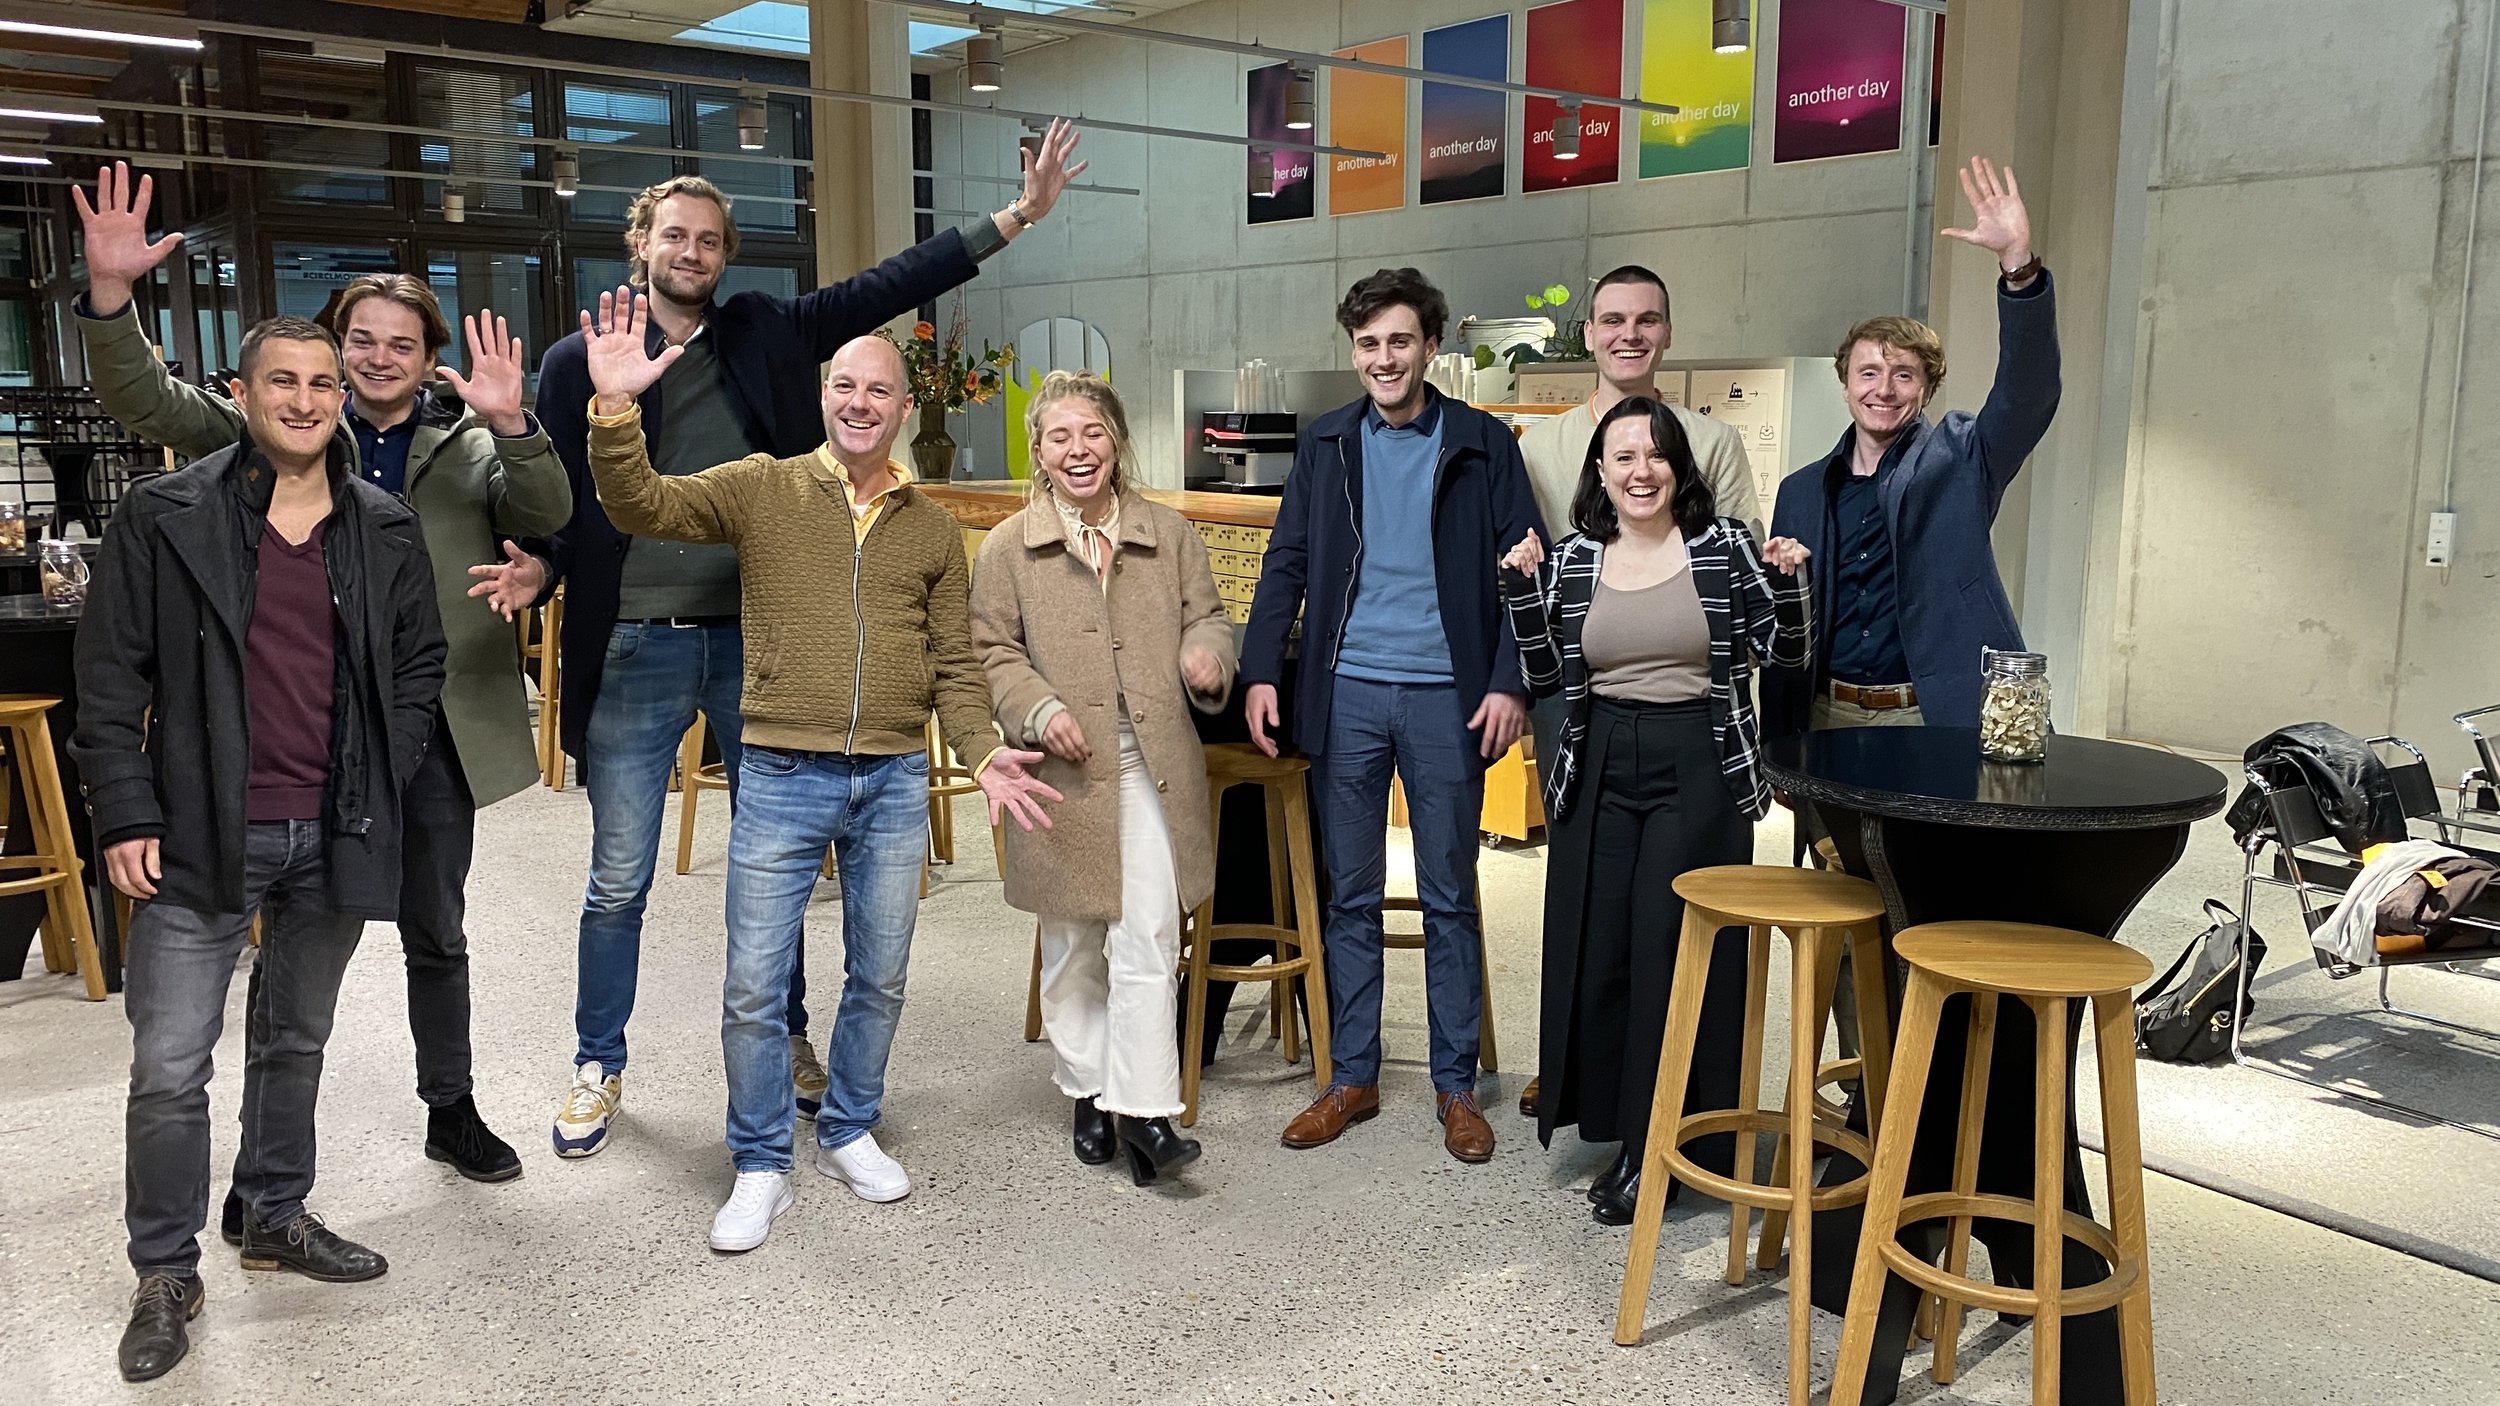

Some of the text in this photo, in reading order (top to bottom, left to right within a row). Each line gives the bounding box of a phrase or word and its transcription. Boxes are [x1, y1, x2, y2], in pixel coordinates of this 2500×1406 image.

[1788, 79, 1891, 107] another day
[1651, 101, 1741, 126] another day
[1585, 119, 1611, 137] day
[1429, 136, 1498, 159] another day
[1290, 164, 1309, 180] day
[1336, 157, 1376, 172] another
